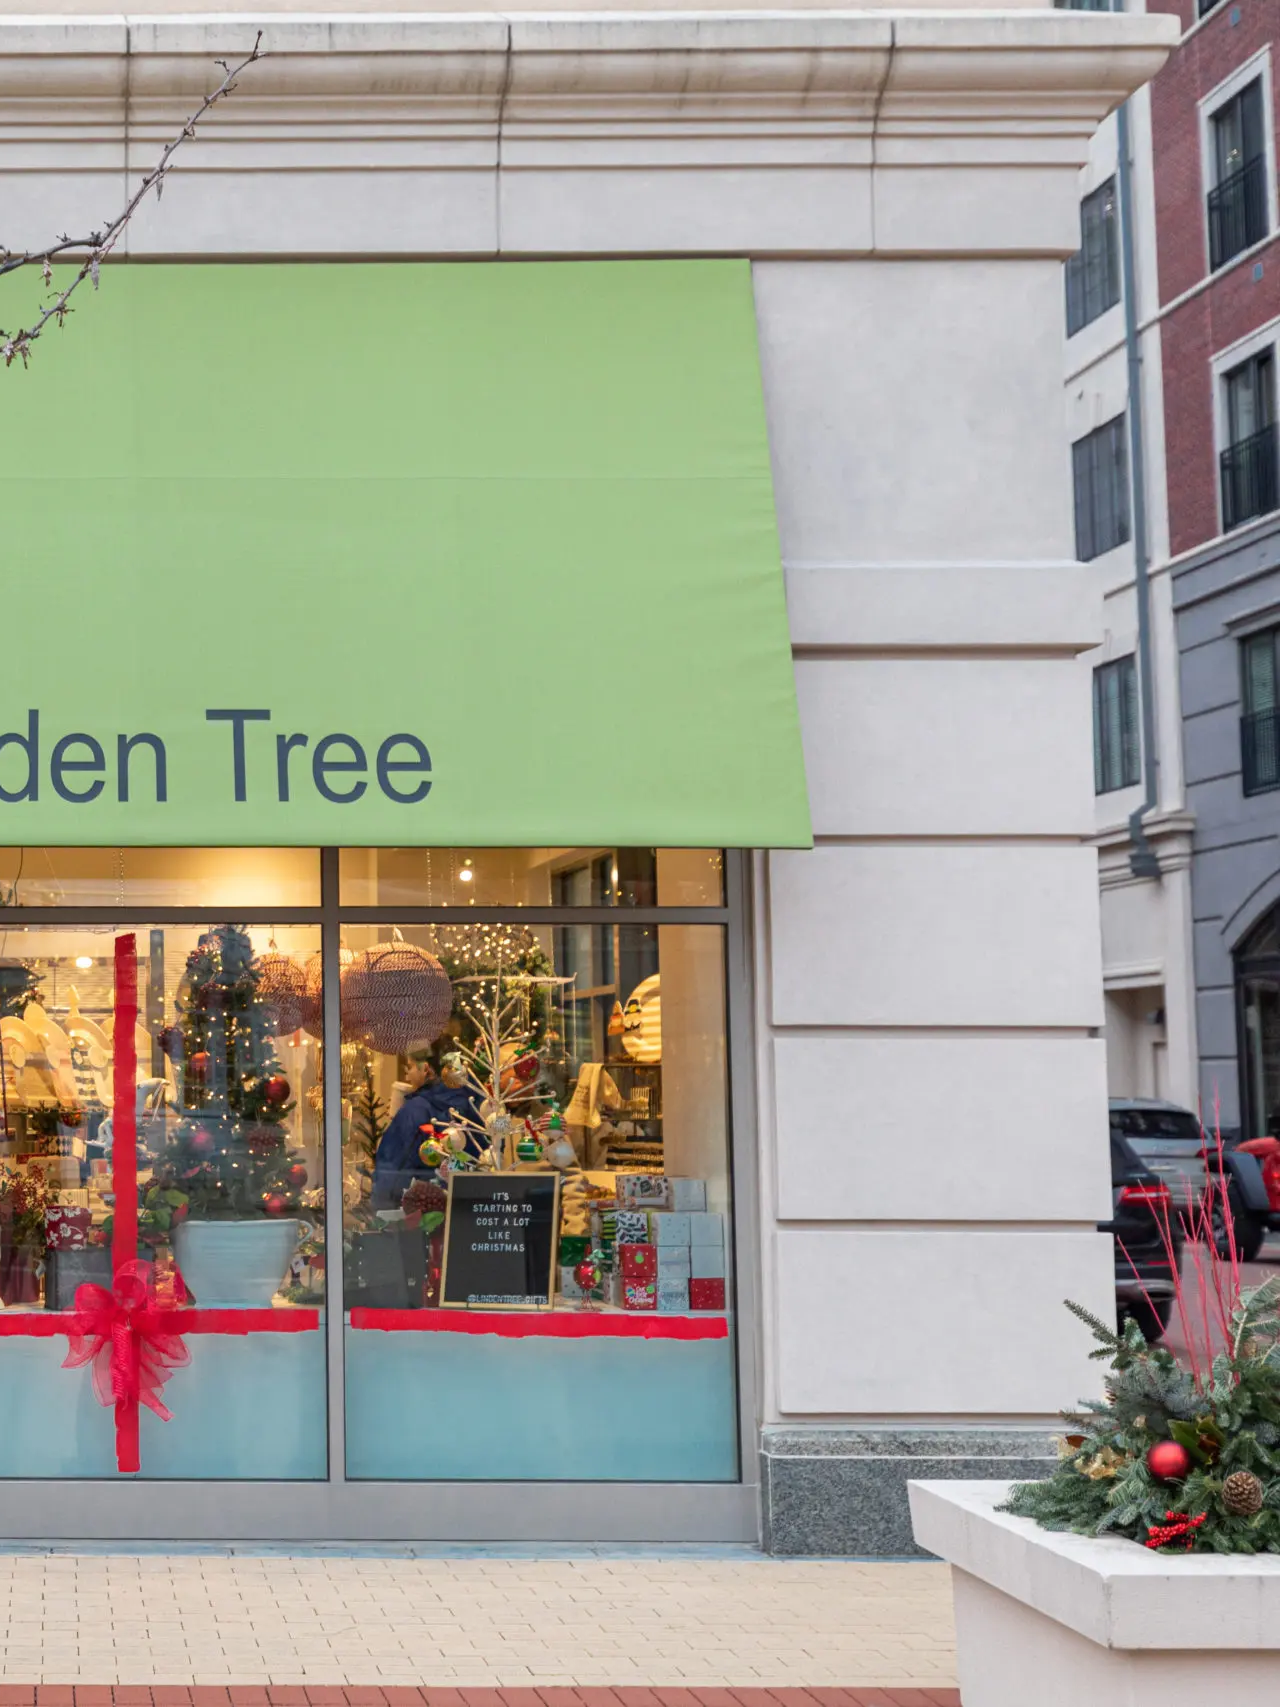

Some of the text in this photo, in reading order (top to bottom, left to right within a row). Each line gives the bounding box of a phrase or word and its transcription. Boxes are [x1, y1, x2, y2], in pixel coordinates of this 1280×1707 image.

[205, 708, 433, 804] Tree
[493, 1192, 509, 1201] IT'S
[473, 1204, 533, 1212] STARTING TO
[476, 1217, 530, 1226] COST A LOT
[488, 1231, 510, 1240] LIKE
[471, 1243, 525, 1252] CHRISTMAS
